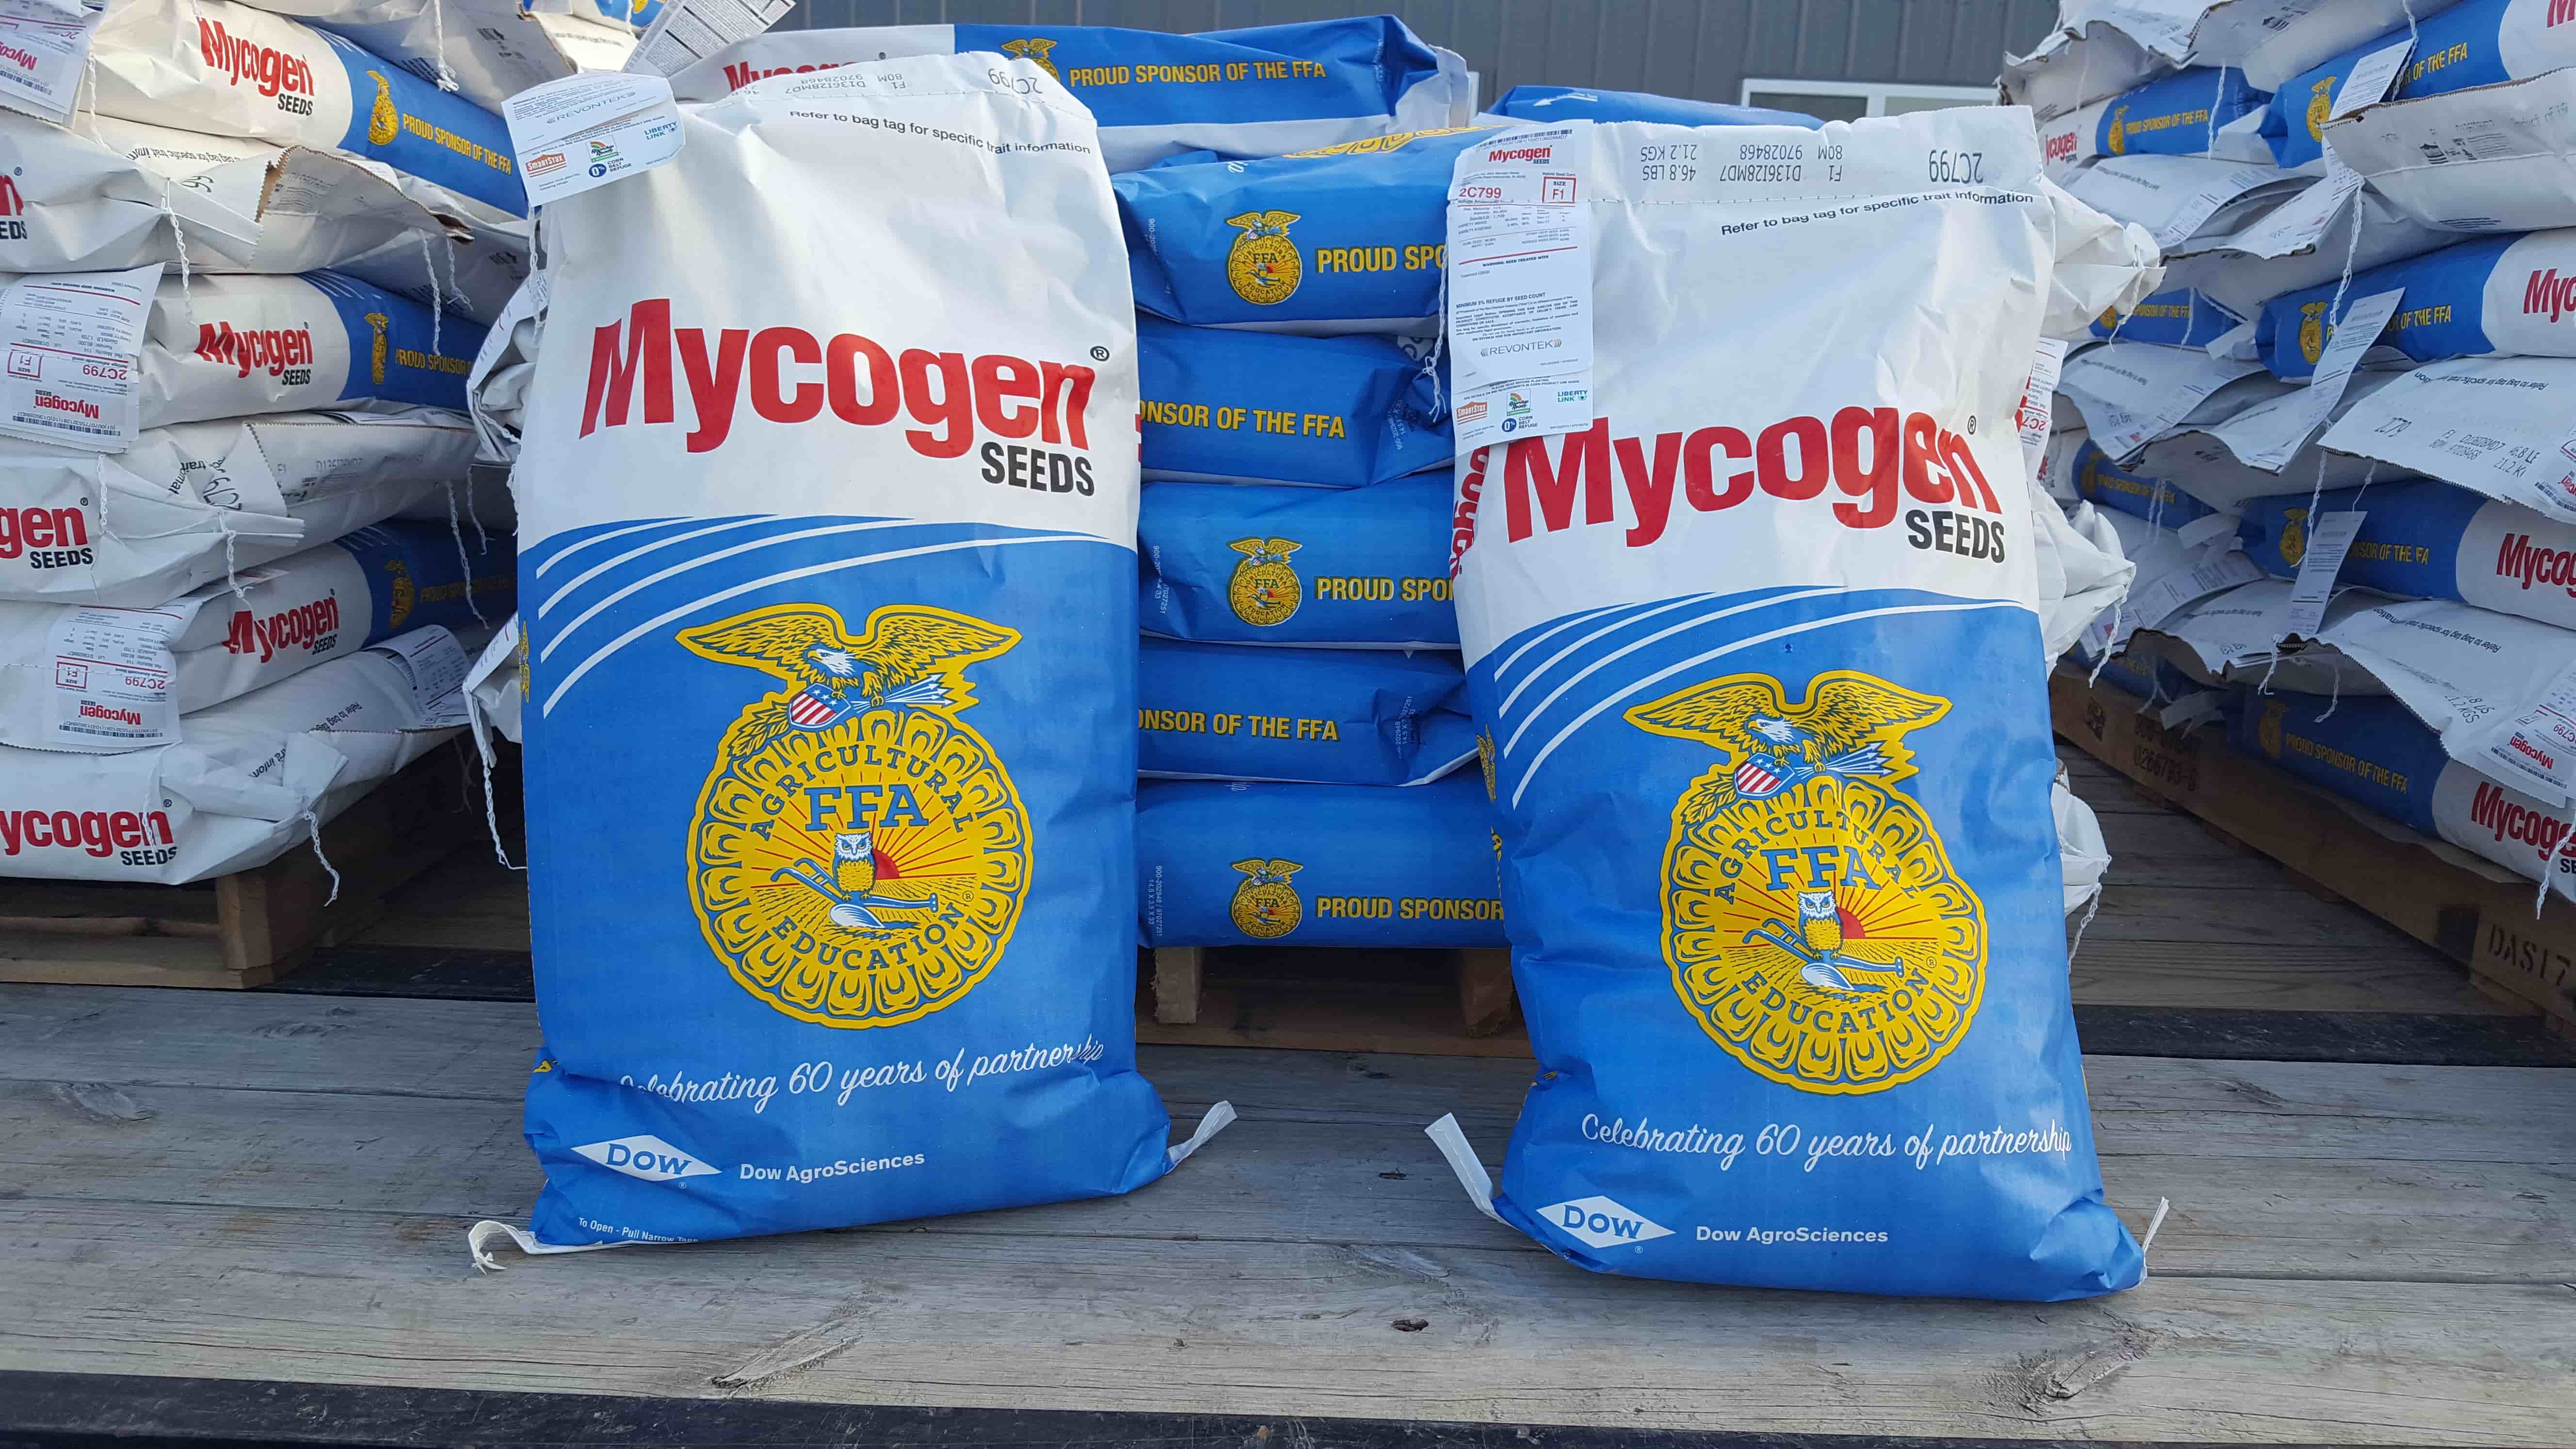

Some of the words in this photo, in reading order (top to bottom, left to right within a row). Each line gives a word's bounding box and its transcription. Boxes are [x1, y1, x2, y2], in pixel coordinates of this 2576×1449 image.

[197, 16, 314, 97] Mycogen
[2413, 59, 2426, 82] OF
[2427, 51, 2445, 73] THE
[2447, 42, 2468, 65] FFA
[1069, 66, 1130, 88] PROUD
[1135, 63, 1221, 85] SPONSOR
[1226, 62, 1250, 82] OF
[1256, 61, 1288, 80] THE
[1292, 60, 1327, 80] FFA
[277, 93, 313, 117] SEEDS
[644, 121, 677, 135] LIBERTY
[646, 130, 667, 140] LINK
[790, 109, 829, 121] Refer
[834, 112, 848, 123] to
[852, 113, 879, 129] bag
[883, 116, 905, 133] tag
[910, 121, 929, 135] for
[933, 126, 984, 149] specific
[987, 139, 1011, 155] trait
[1014, 141, 1091, 155] information
[403, 113, 433, 141] PROUD
[435, 125, 471, 156] SPONSOR
[472, 138, 483, 160] OF
[484, 143, 499, 169] THE
[499, 149, 512, 176] FFA
[1488, 147, 1551, 163] Mycogen
[1641, 145, 1666, 162] KGS
[1670, 144, 1697, 161] 21.2
[1739, 144, 1803, 161] 97028468
[1818, 145, 1843, 160] 80M
[1642, 165, 1667, 181] LBS
[1669, 165, 1697, 183] 46.8
[1828, 165, 1842, 183] F1
[1928, 149, 1984, 184] 2C799
[1459, 187, 1502, 199] 2C799
[1552, 189, 1564, 200] F1
[1720, 220, 1760, 236] Refer
[1763, 216, 1779, 228] to
[1782, 212, 1809, 228] bag
[1813, 209, 1836, 223] tag
[1840, 205, 1859, 216] for
[1864, 196, 1919, 213] specific
[1923, 191, 1951, 202] trait
[1954, 191, 2034, 205] information
[1252, 253, 1278, 264] FFA
[1317, 245, 1397, 273] PROUD
[2400, 315, 2411, 331] OF
[2414, 310, 2431, 327] THE
[2433, 305, 2452, 324] FFA
[19, 354, 32, 366] F1
[1489, 340, 1553, 356] REVONTEK
[82, 364, 129, 381] 2C799
[282, 368, 311, 386] SEEDS
[427, 353, 465, 377] SPONSOR
[578, 296, 1096, 460] Mycogen
[34, 395, 100, 420] Mycogen
[1216, 406, 1246, 431] OF
[1253, 409, 1296, 435] THE
[1302, 413, 1345, 438] FFA
[980, 440, 1096, 497] SEEDS
[1503, 404, 2003, 548] Mycogen
[1904, 509, 2006, 564] SEEDS
[30, 548, 94, 569] SEEDS
[2379, 543, 2392, 561] OF
[2393, 545, 2412, 564] THE
[1255, 578, 1279, 589] FFA
[1317, 577, 1394, 602] PROUD
[311, 634, 338, 656] SEEDS
[124, 676, 165, 690] 2C799
[80, 705, 142, 725] Mycogen
[1213, 713, 1241, 736] OF
[1248, 715, 1291, 740] THE
[1297, 718, 1338, 741] FFA
[2286, 733, 2314, 757] PROUD
[2316, 740, 2356, 773] SPONSOR
[2357, 756, 2371, 779] OF
[2372, 762, 2389, 788] THE
[2390, 773, 2410, 795] FFA
[2509, 736, 2554, 770] Mycogen
[750, 743, 975, 841] AGRICULTURAL
[804, 783, 930, 832] FFA
[121, 846, 178, 867] SEEDS
[1715, 808, 1920, 906] AGRICULTURAL
[1760, 846, 1883, 892] FFA
[1256, 898, 1280, 907] FFA
[1316, 896, 1392, 919] PROUD
[1399, 897, 1504, 920] SPONSOR
[772, 901, 966, 970] EDUCATION
[1745, 966, 1930, 1033] EDUCATION
[788, 1061, 833, 1095] 60
[837, 1062, 927, 1107] years
[934, 1048, 967, 1093] of
[967, 1033, 1105, 1088] partnership
[1581, 1113, 1746, 1170] Celebrating
[1755, 1124, 1802, 1156] 60
[1805, 1133, 1896, 1173] years
[1904, 1123, 1935, 1170] of
[1937, 1118, 2073, 1164] partnership
[739, 1163, 782, 1181] Dow
[786, 1152, 926, 1185] AgroSciences
[579, 1217, 587, 1228] To
[590, 1220, 613, 1233] Open
[622, 1226, 640, 1239] Pull
[642, 1231, 675, 1242] Narrow
[1695, 1225, 1741, 1242] Dow
[1745, 1226, 1889, 1244] AgroSciences
